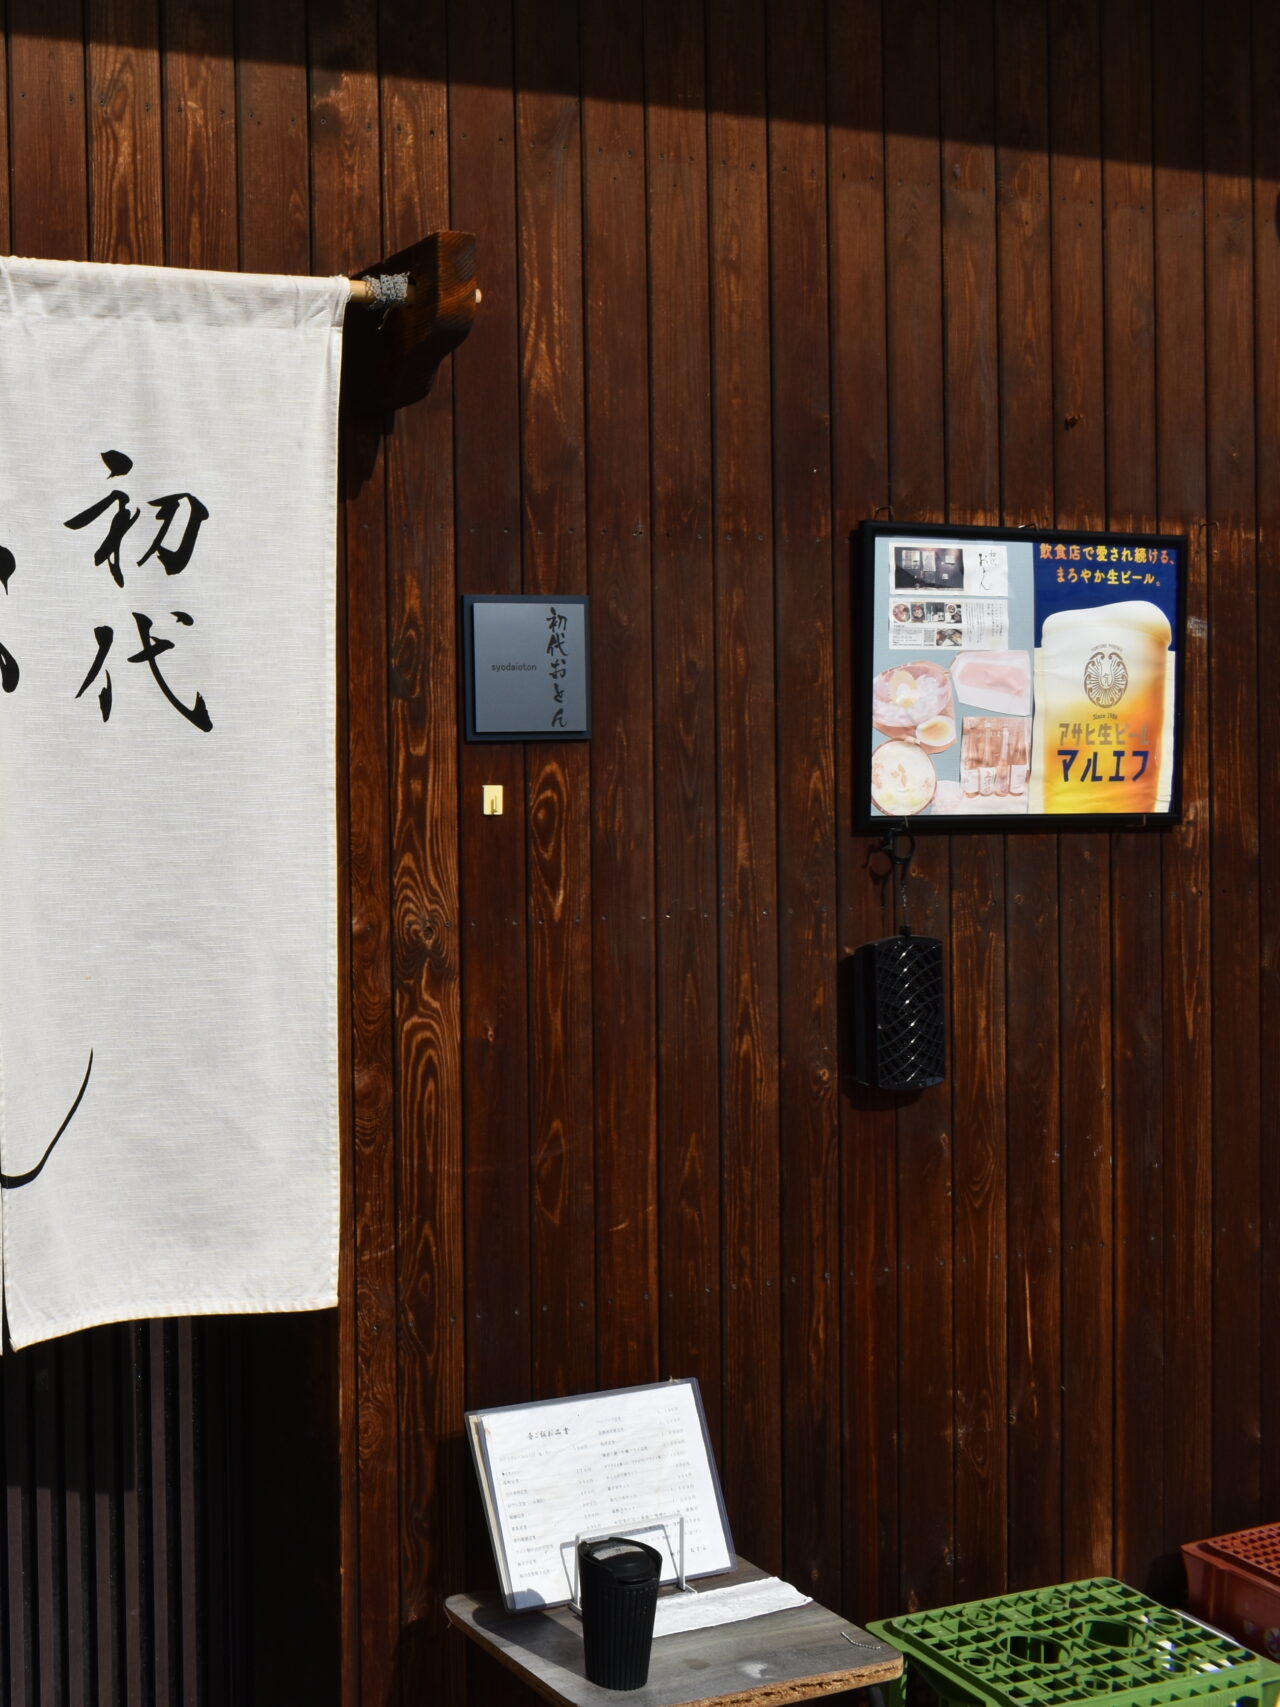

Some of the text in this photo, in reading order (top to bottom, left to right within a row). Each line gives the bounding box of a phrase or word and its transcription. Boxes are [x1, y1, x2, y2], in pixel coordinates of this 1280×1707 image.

[1040, 543, 1175, 565] 飲食店で愛され続ける、
[1056, 567, 1161, 587] まろやか生ビール。
[63, 449, 213, 732] 初代
[491, 663, 537, 672] syodaioton
[546, 607, 568, 728] 初代おとん
[1059, 722, 1152, 747] アサヒ生ビール
[1057, 750, 1150, 783] マルエフ
